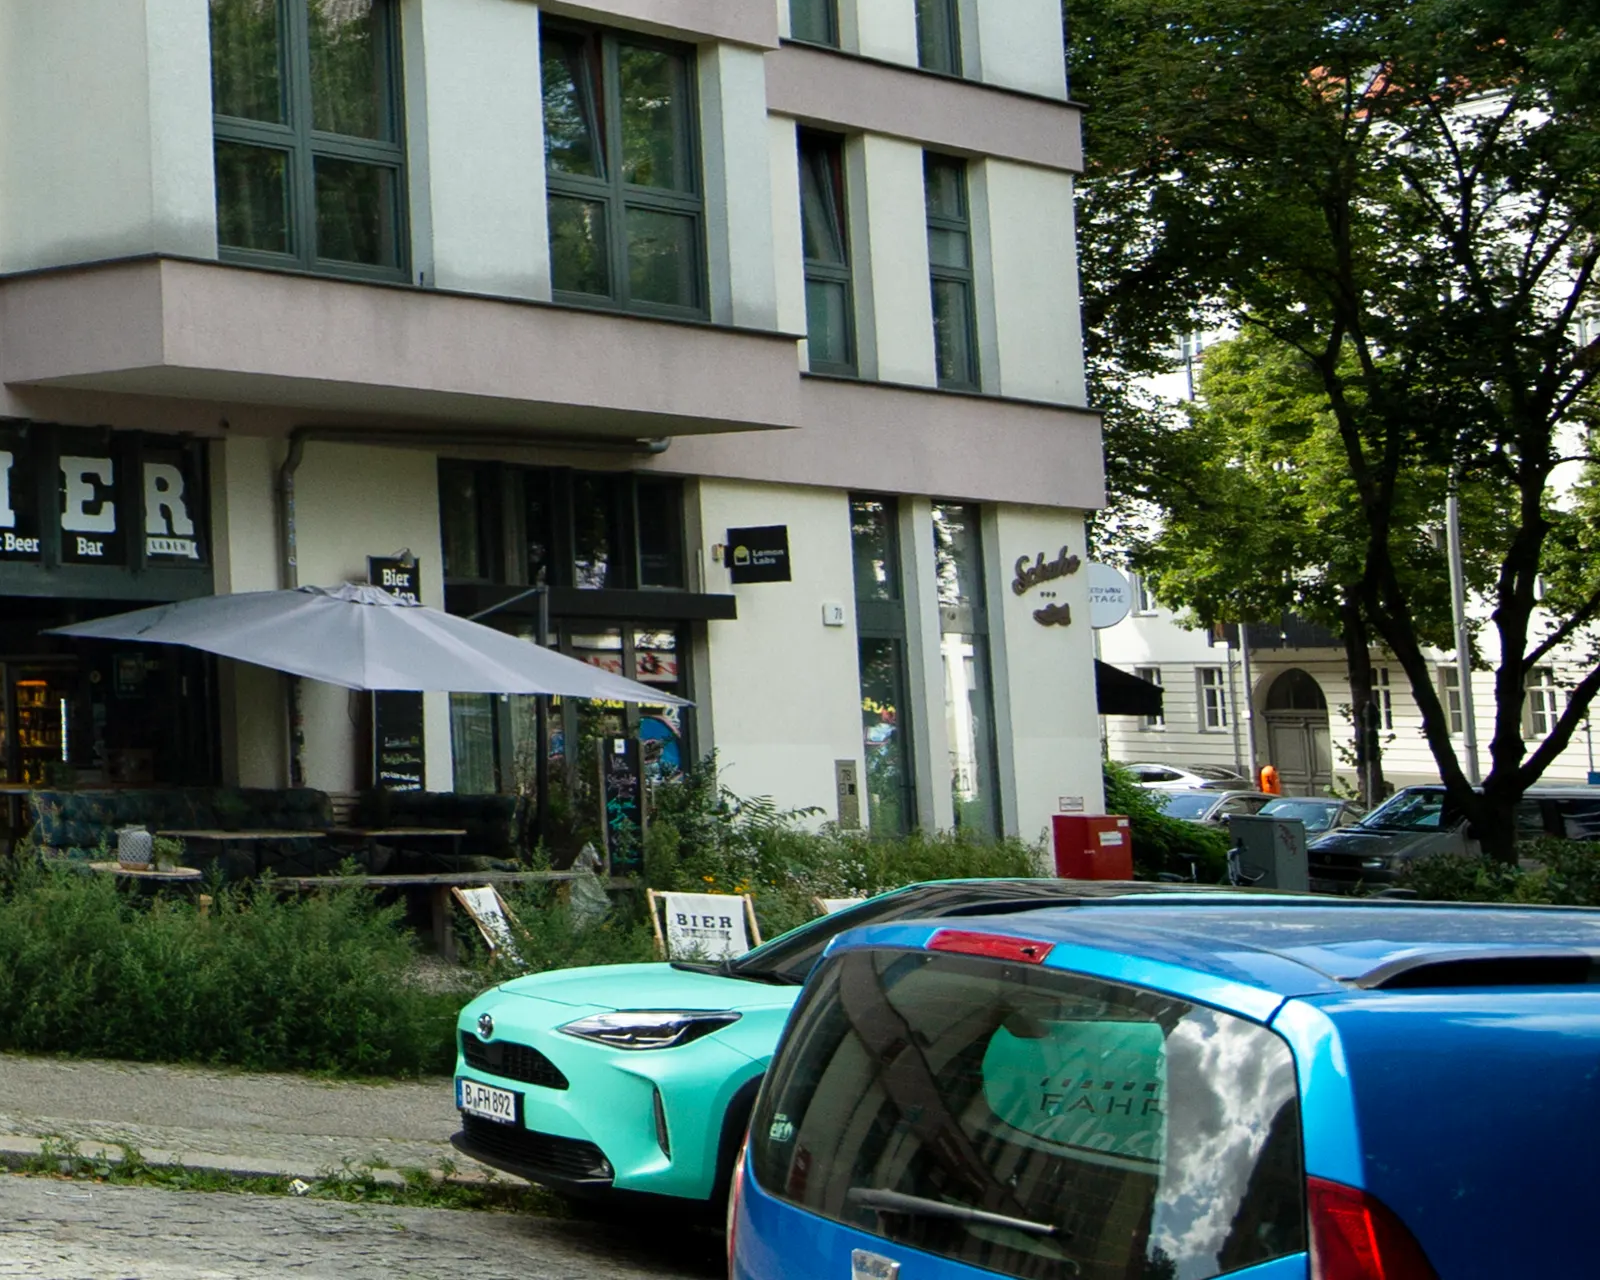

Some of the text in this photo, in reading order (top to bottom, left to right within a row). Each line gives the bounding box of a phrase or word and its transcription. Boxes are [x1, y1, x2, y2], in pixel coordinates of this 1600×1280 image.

[4, 533, 39, 552] Beer
[76, 537, 103, 556] Bar
[752, 549, 784, 557] Lemon
[752, 556, 776, 565] Labs
[382, 568, 410, 587] Bier
[1089, 595, 1124, 604] TAGE
[676, 913, 733, 928] BIER
[465, 1084, 511, 1117] B FH 892
